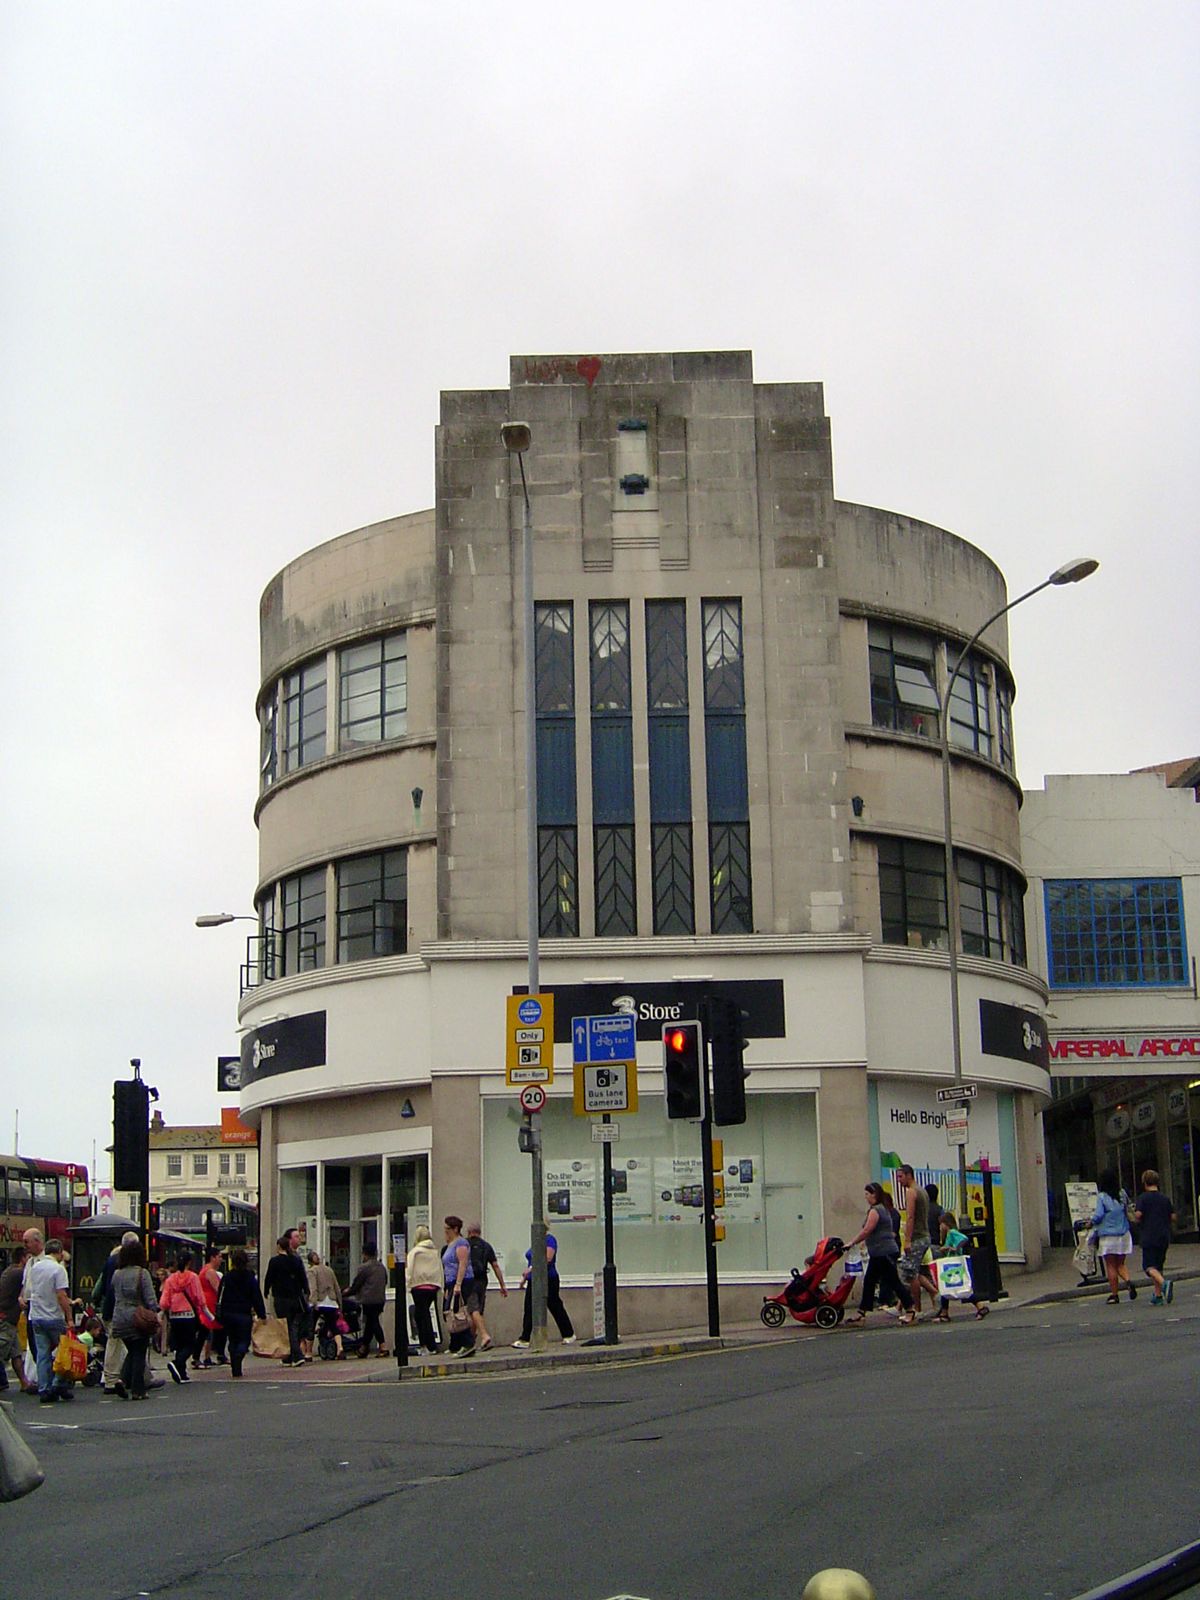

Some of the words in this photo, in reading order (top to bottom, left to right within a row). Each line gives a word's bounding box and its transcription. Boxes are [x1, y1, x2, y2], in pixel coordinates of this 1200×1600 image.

[640, 1003, 681, 1020] Store
[520, 1032, 539, 1040] Only
[252, 1039, 261, 1068] 3
[260, 1043, 276, 1059] Store
[1047, 1040, 1134, 1058] MPERIAL
[224, 1061, 240, 1087] 3
[524, 1092, 542, 1104] 20
[588, 1090, 604, 1098] Bus
[606, 1089, 624, 1097] lane
[890, 1108, 917, 1124] Hello
[920, 1110, 947, 1129] Brigh
[67, 1166, 76, 1175] H
[560, 1172, 573, 1180] the
[571, 1180, 592, 1188] thing
